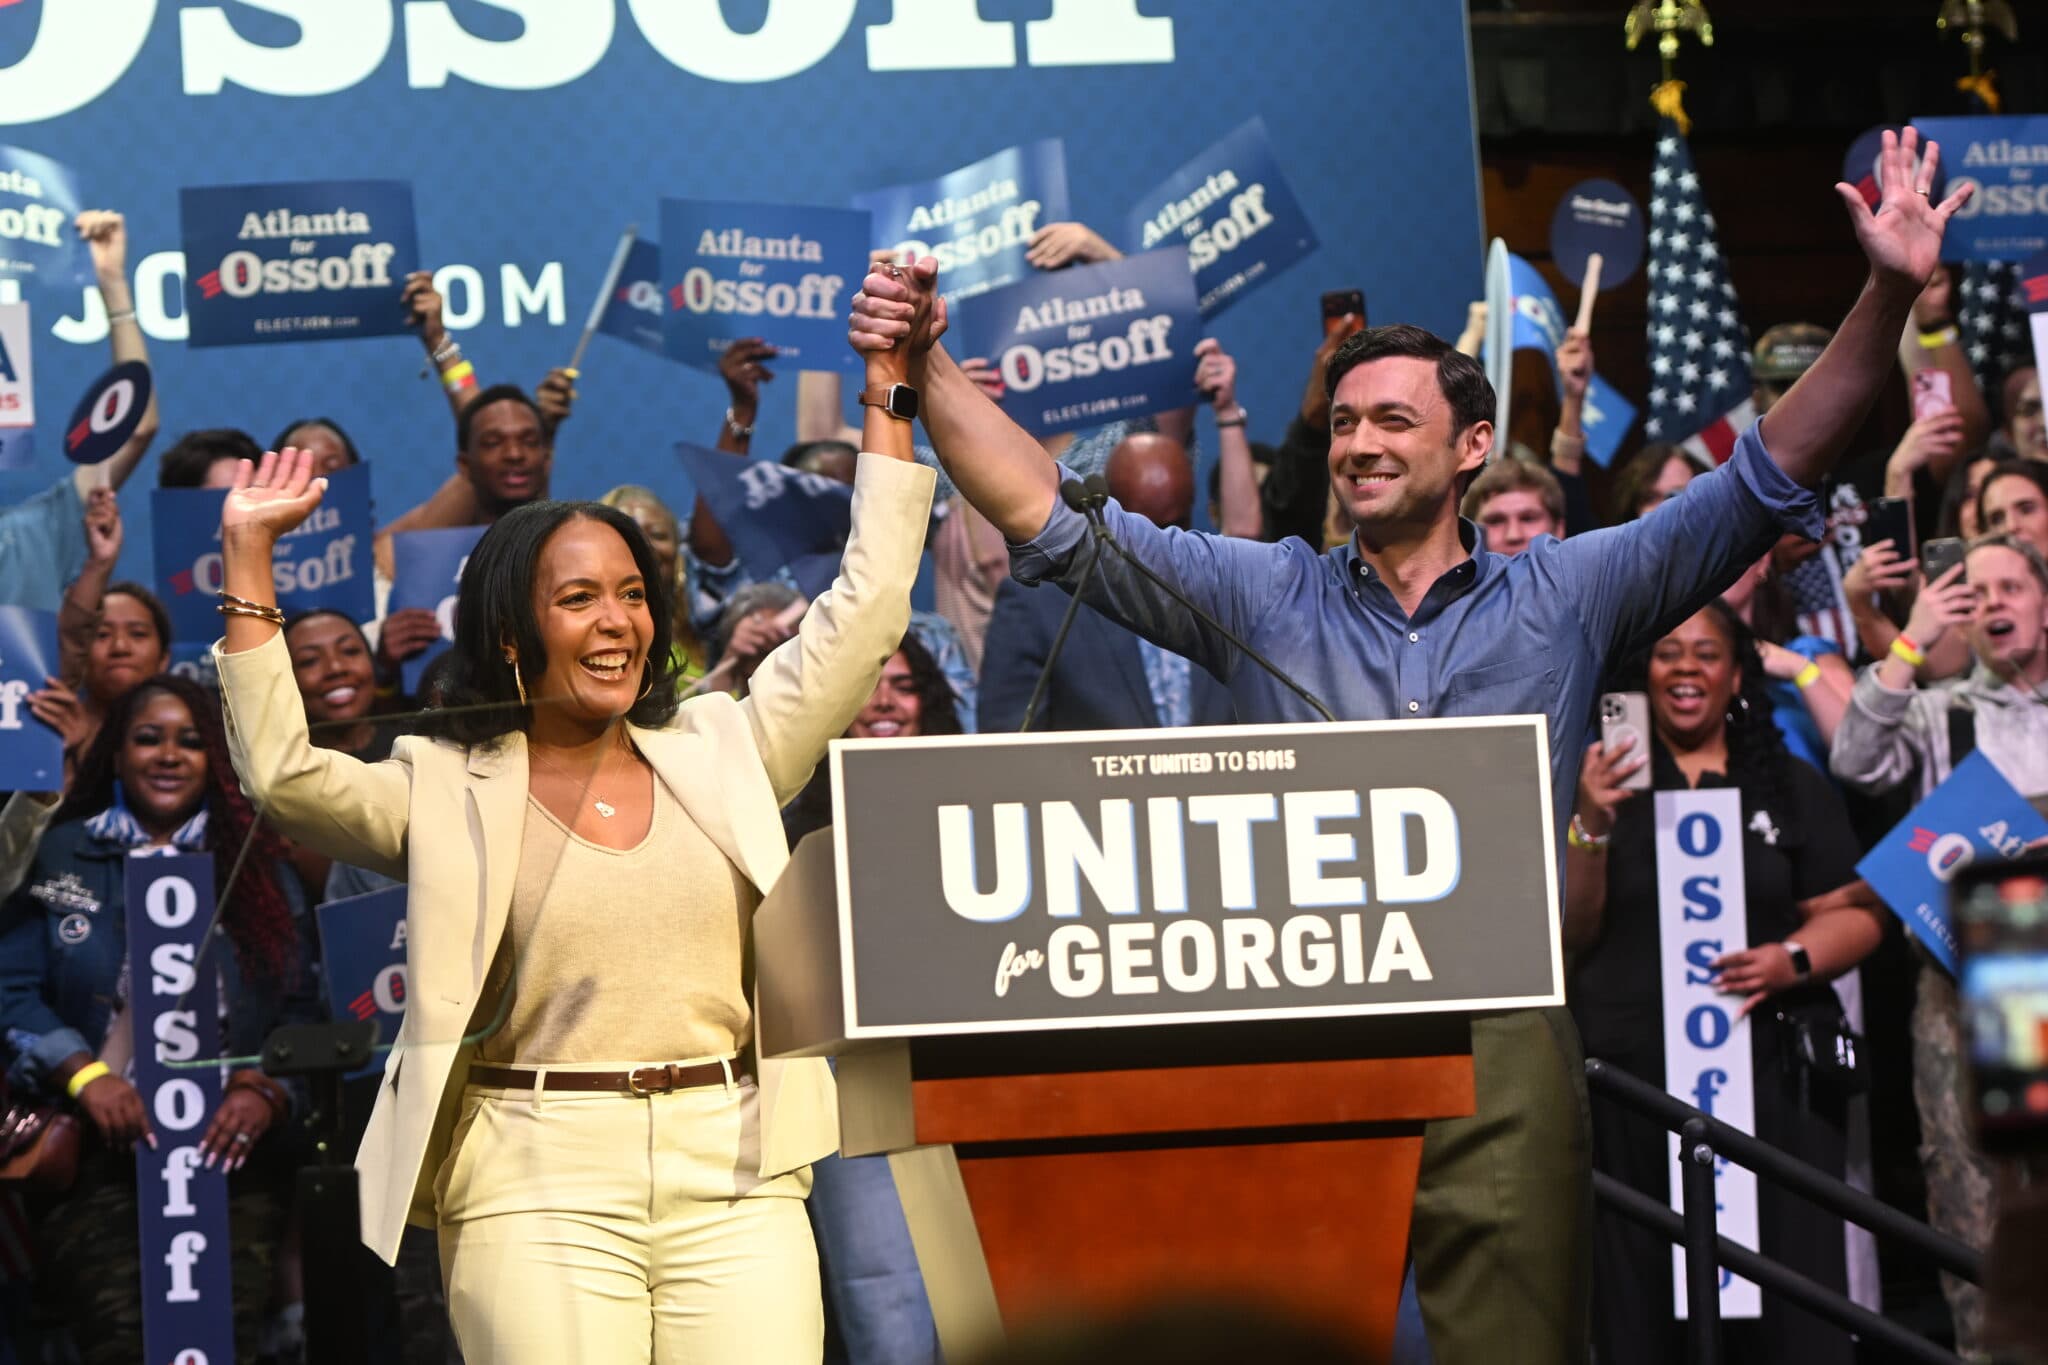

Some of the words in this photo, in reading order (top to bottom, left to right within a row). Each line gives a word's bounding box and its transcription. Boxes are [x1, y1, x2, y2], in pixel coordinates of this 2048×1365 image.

[237, 206, 372, 240] Atlanta
[907, 179, 1019, 232] Atlanta
[1142, 169, 1240, 249] Atlanta
[219, 242, 396, 298] Ossoff
[289, 239, 317, 255] for
[697, 228, 823, 262] Atlanta
[683, 267, 844, 319] Ossoff
[1014, 286, 1146, 334] Atlanta
[1001, 314, 1174, 391] Ossoff
[1091, 755, 1147, 777] TEXT
[1149, 752, 1213, 775] UNITED
[1214, 751, 1244, 772] TO
[1246, 749, 1297, 771] 51015
[938, 787, 1462, 923] UNITED
[995, 942, 1045, 997] for
[1047, 911, 1434, 998] GEORGIA
